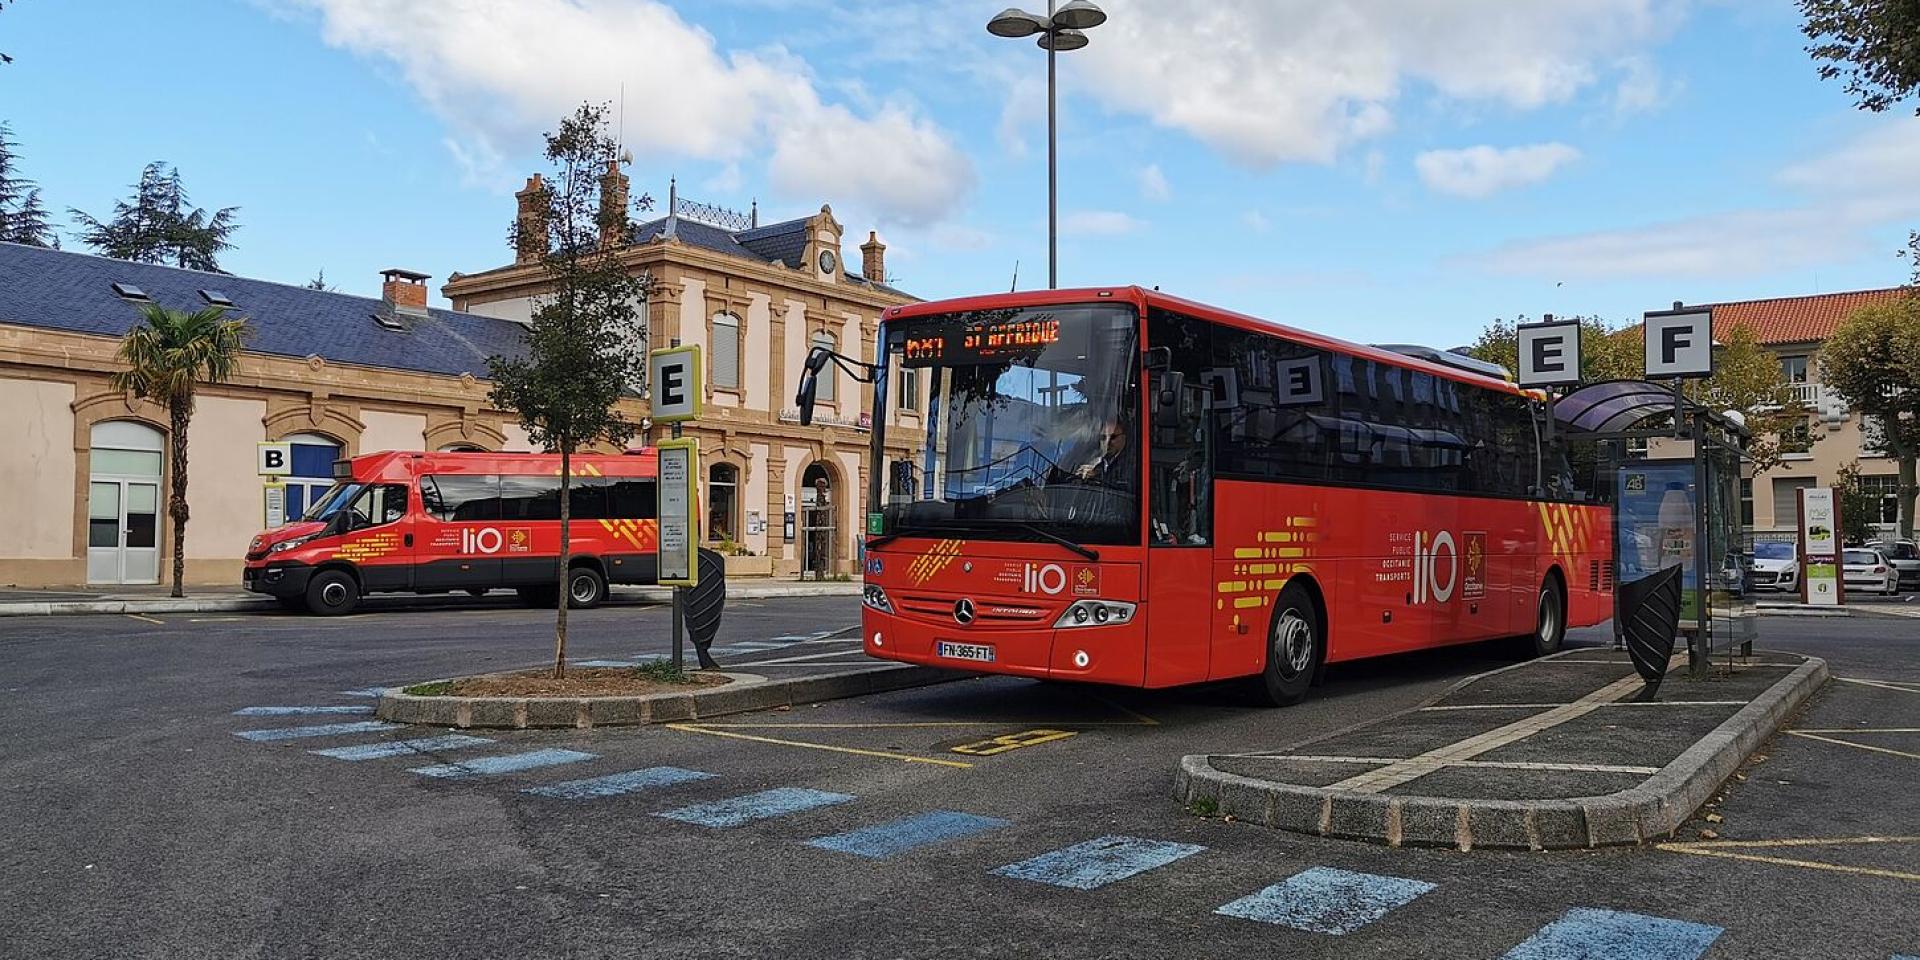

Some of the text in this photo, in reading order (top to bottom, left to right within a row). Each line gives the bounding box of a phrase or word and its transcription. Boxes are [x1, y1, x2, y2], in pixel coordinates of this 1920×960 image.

[988, 320, 1060, 347] AFFRIQUE
[1661, 325, 1693, 364] F
[1531, 336, 1565, 373] E
[661, 363, 684, 406] E
[265, 450, 284, 468] B
[1375, 571, 1411, 582] TRANSPORTS
[943, 644, 988, 659] FN-365-FT
